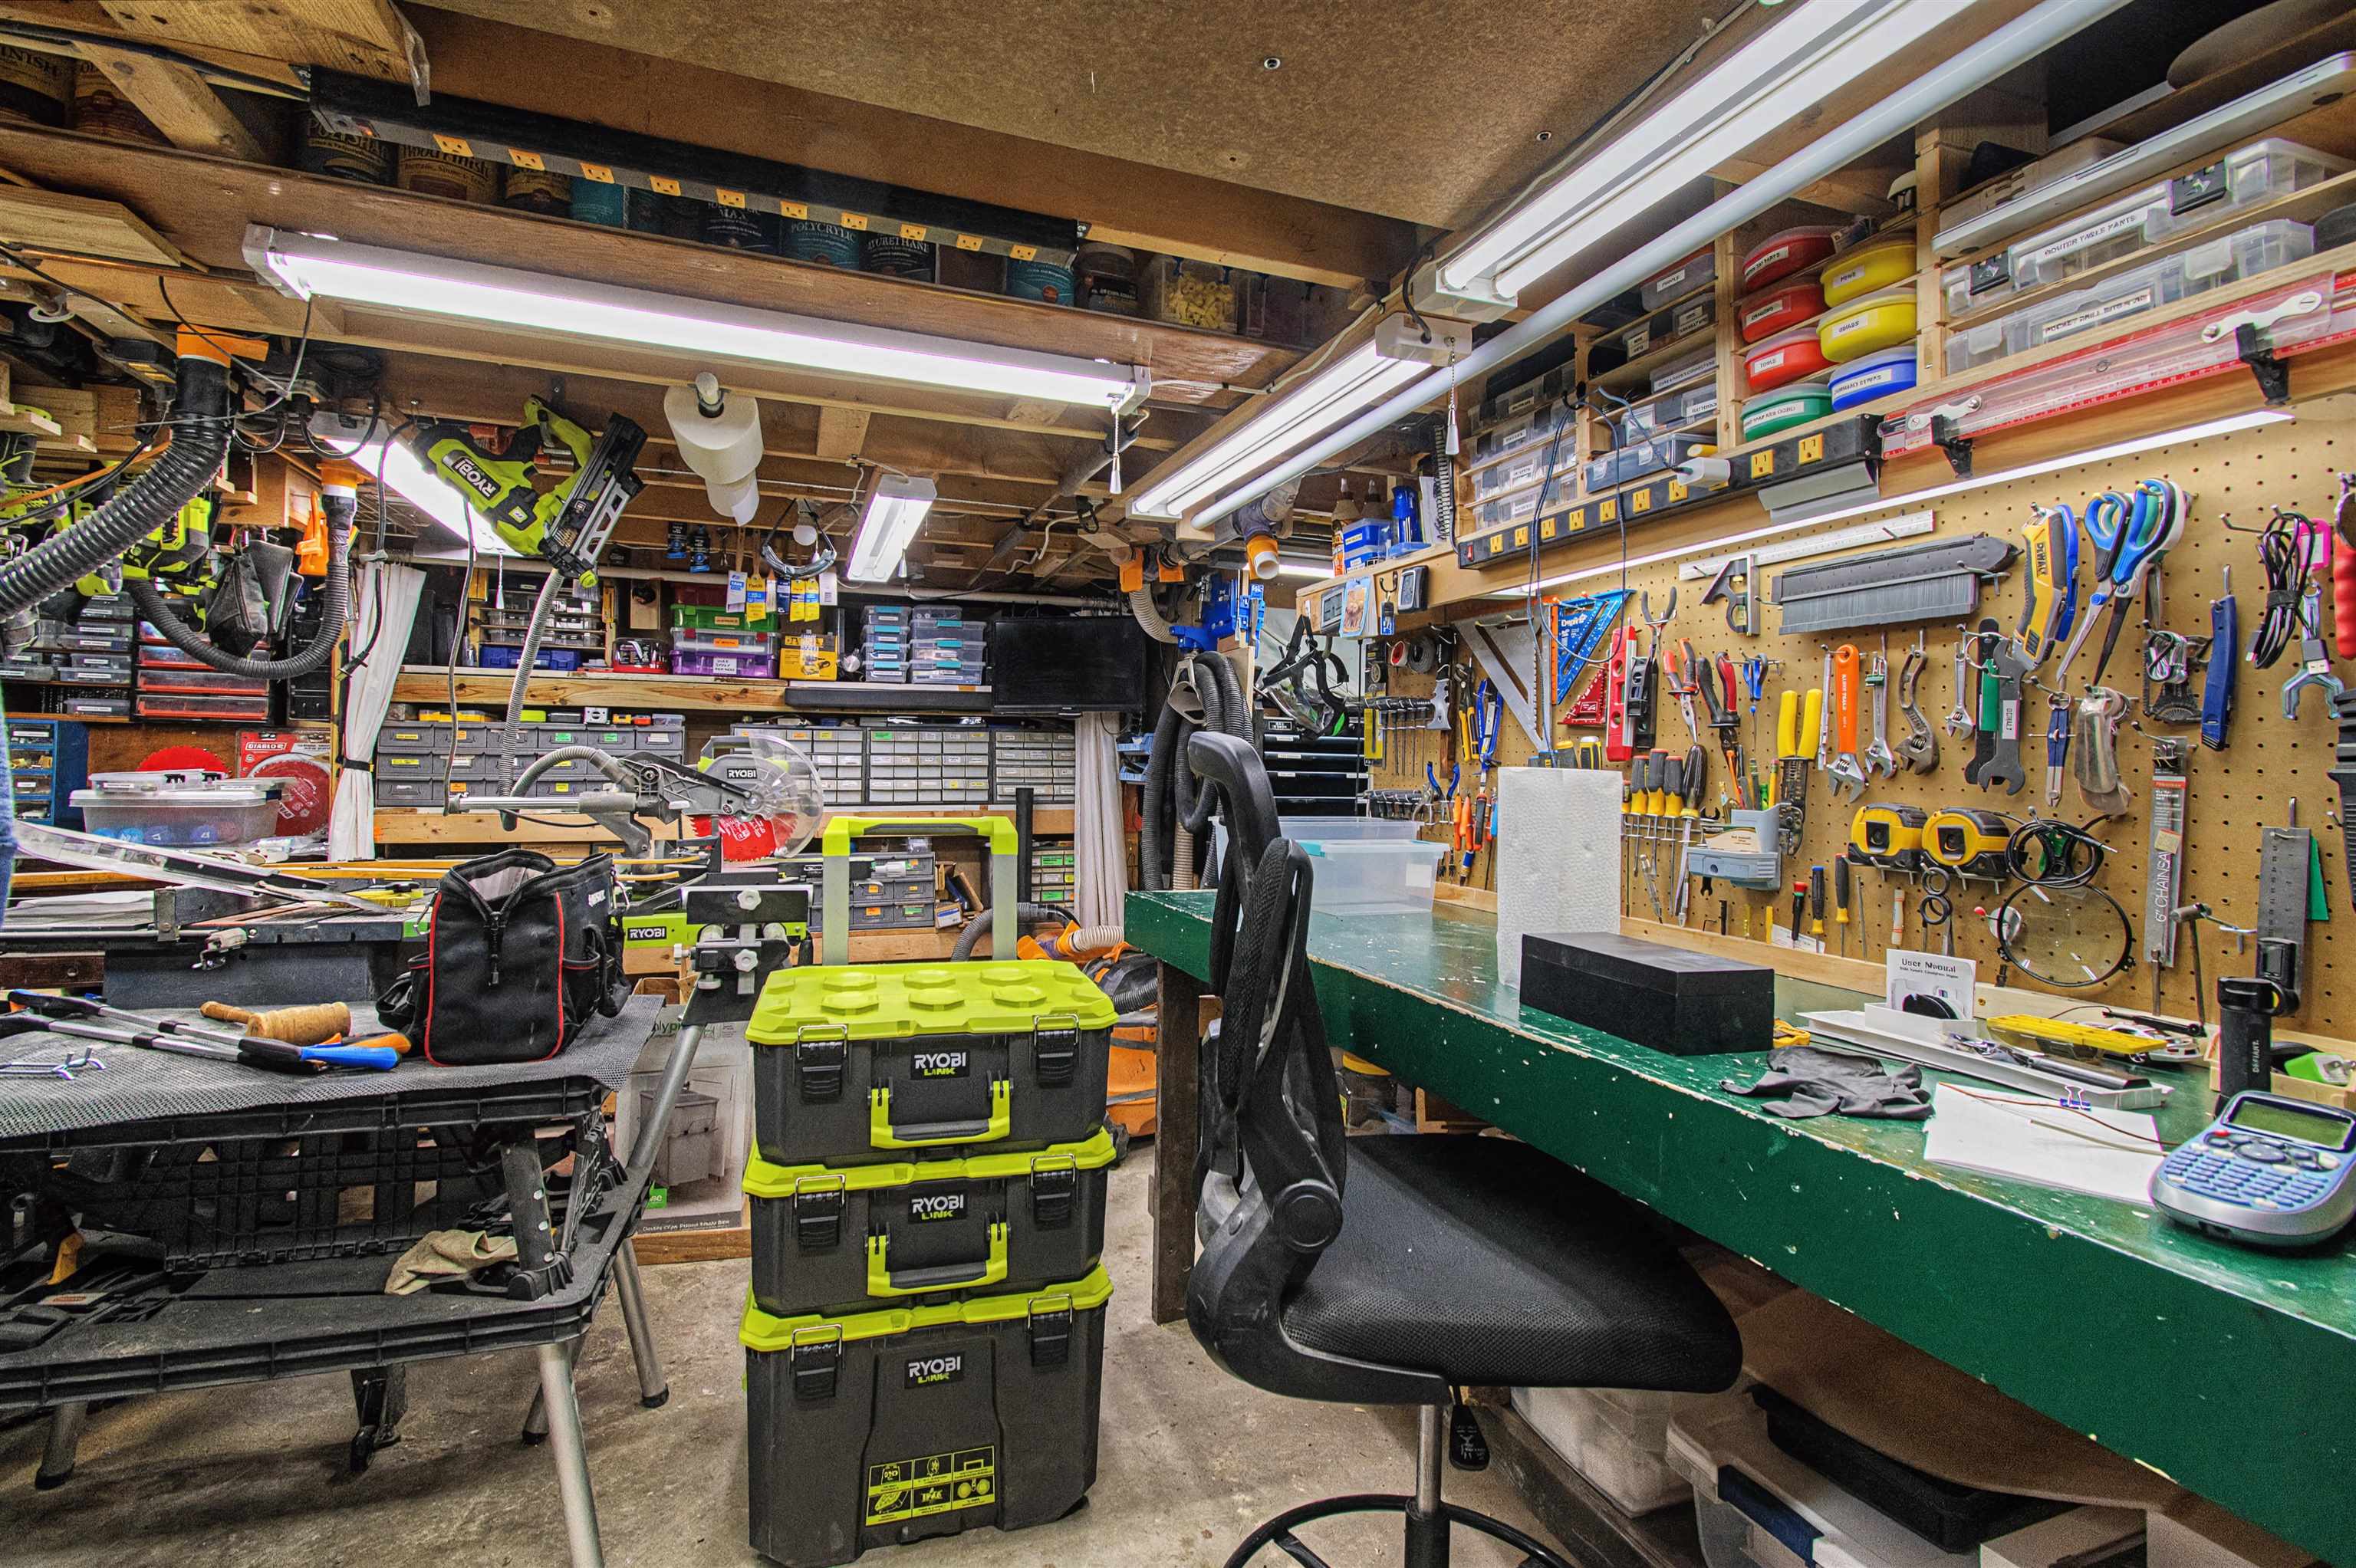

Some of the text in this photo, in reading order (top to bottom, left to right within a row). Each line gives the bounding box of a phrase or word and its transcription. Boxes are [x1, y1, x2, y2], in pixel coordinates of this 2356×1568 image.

[791, 222, 857, 242] POLYCRYLIC
[2080, 227, 2106, 242] TABLE
[454, 458, 496, 498] RYOBI
[2037, 542, 2048, 576] DEWALT
[728, 769, 756, 778] RYOBI
[630, 928, 665, 938] RYOBI
[1901, 958, 1921, 967] User
[1925, 961, 1956, 973] Manual
[914, 1051, 966, 1070] RYOBI
[923, 1067, 956, 1077] LINK
[911, 1194, 964, 1214] RYOBI
[921, 1210, 954, 1221] LINK
[908, 1356, 961, 1378] RYOBI
[917, 1372, 950, 1384] LINK
